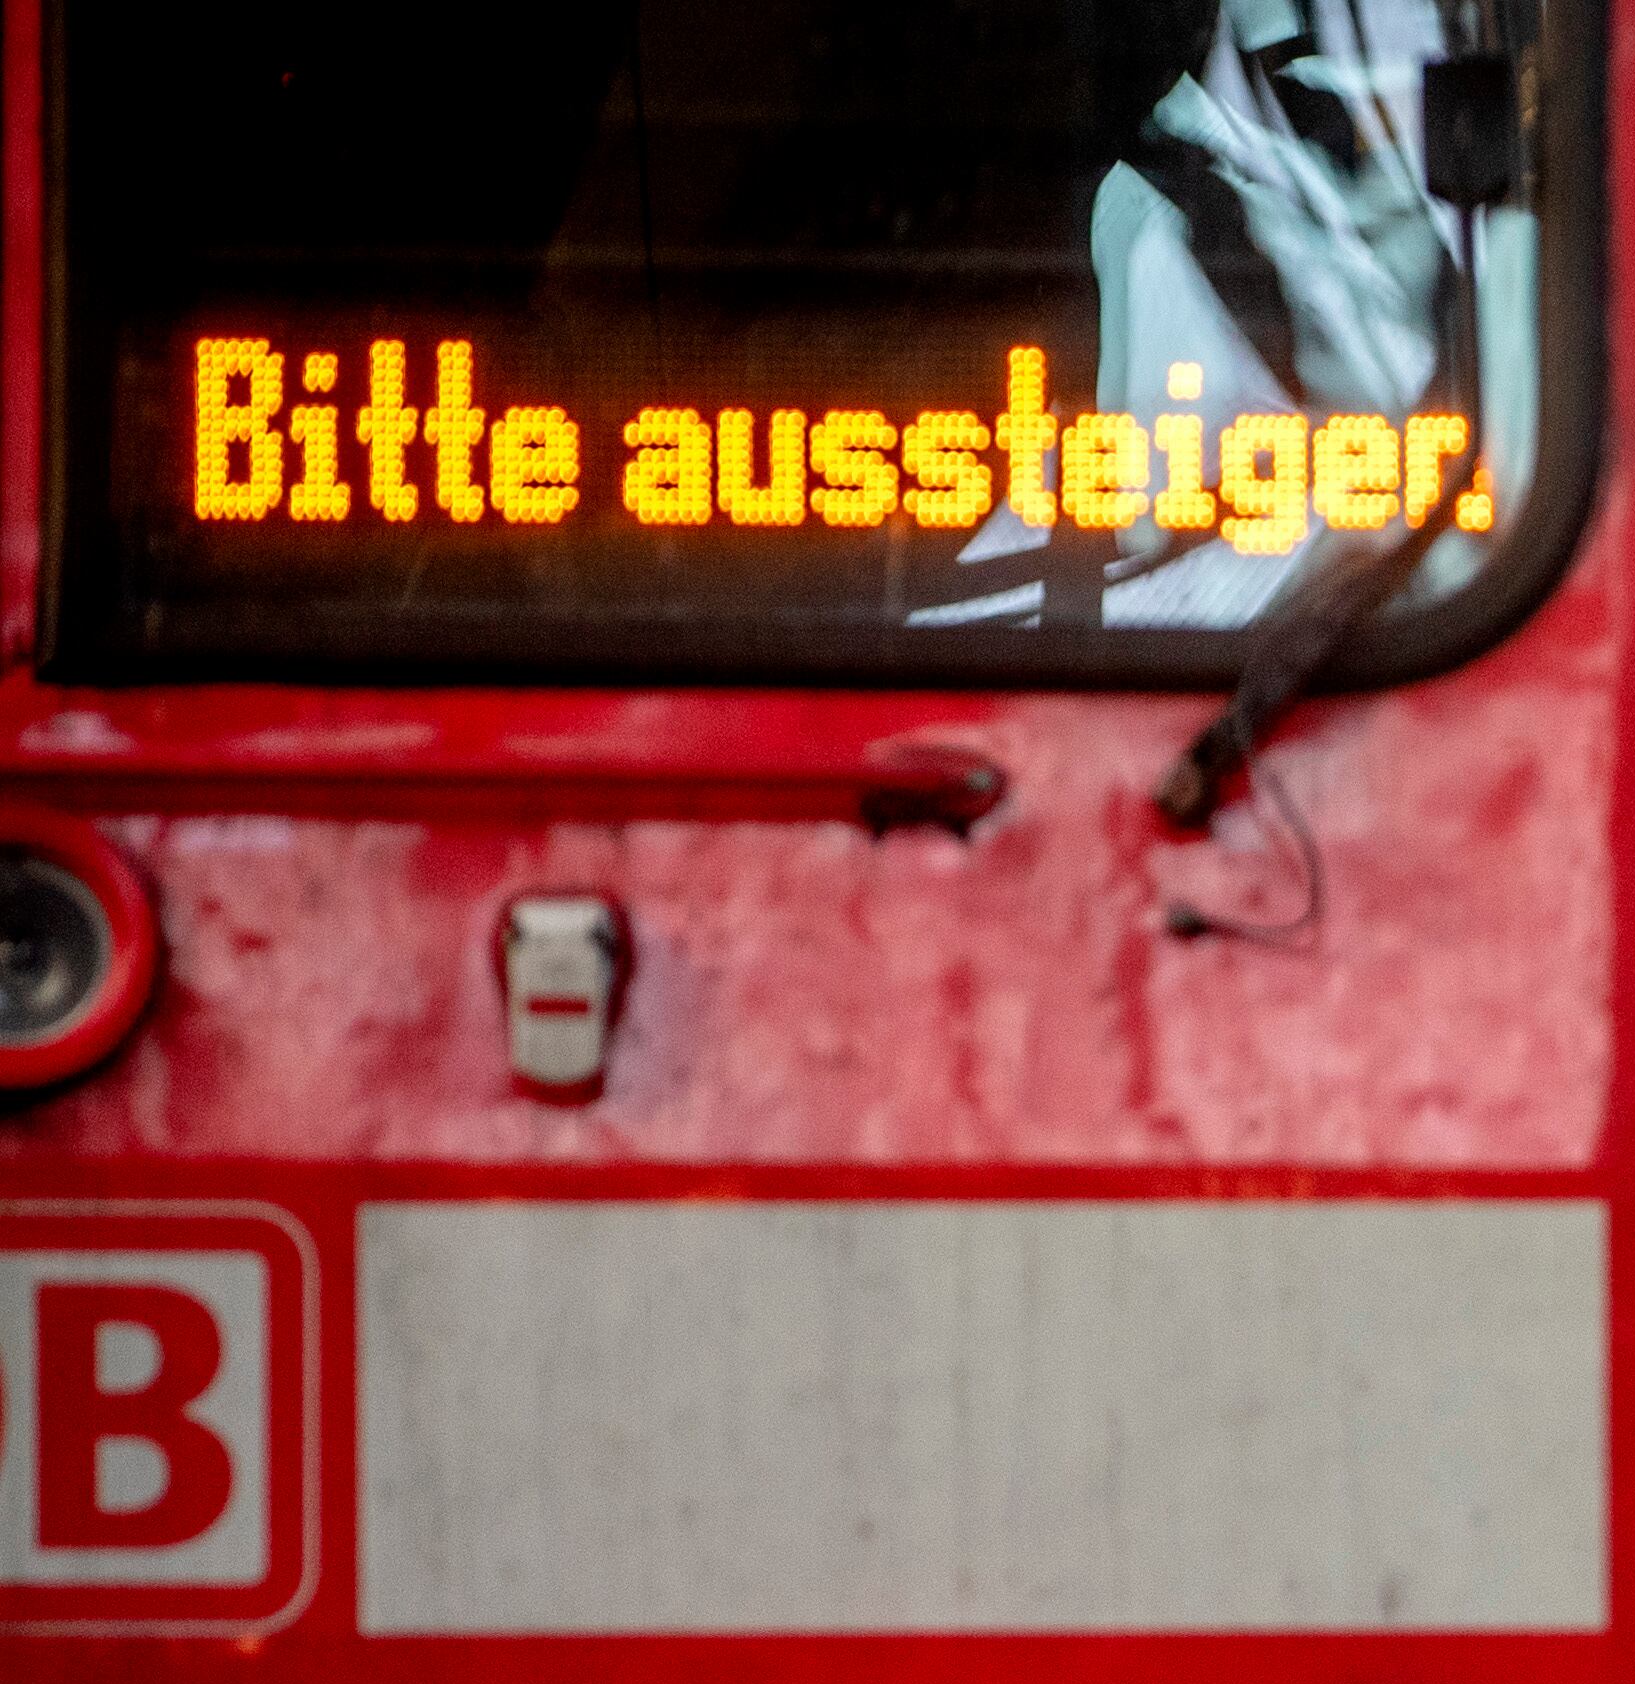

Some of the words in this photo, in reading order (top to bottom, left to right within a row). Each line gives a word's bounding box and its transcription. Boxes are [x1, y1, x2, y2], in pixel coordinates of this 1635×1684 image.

[196, 338, 580, 521] Bitte
[624, 346, 1493, 555] aussteiger.
[0, 1284, 234, 1548] B
